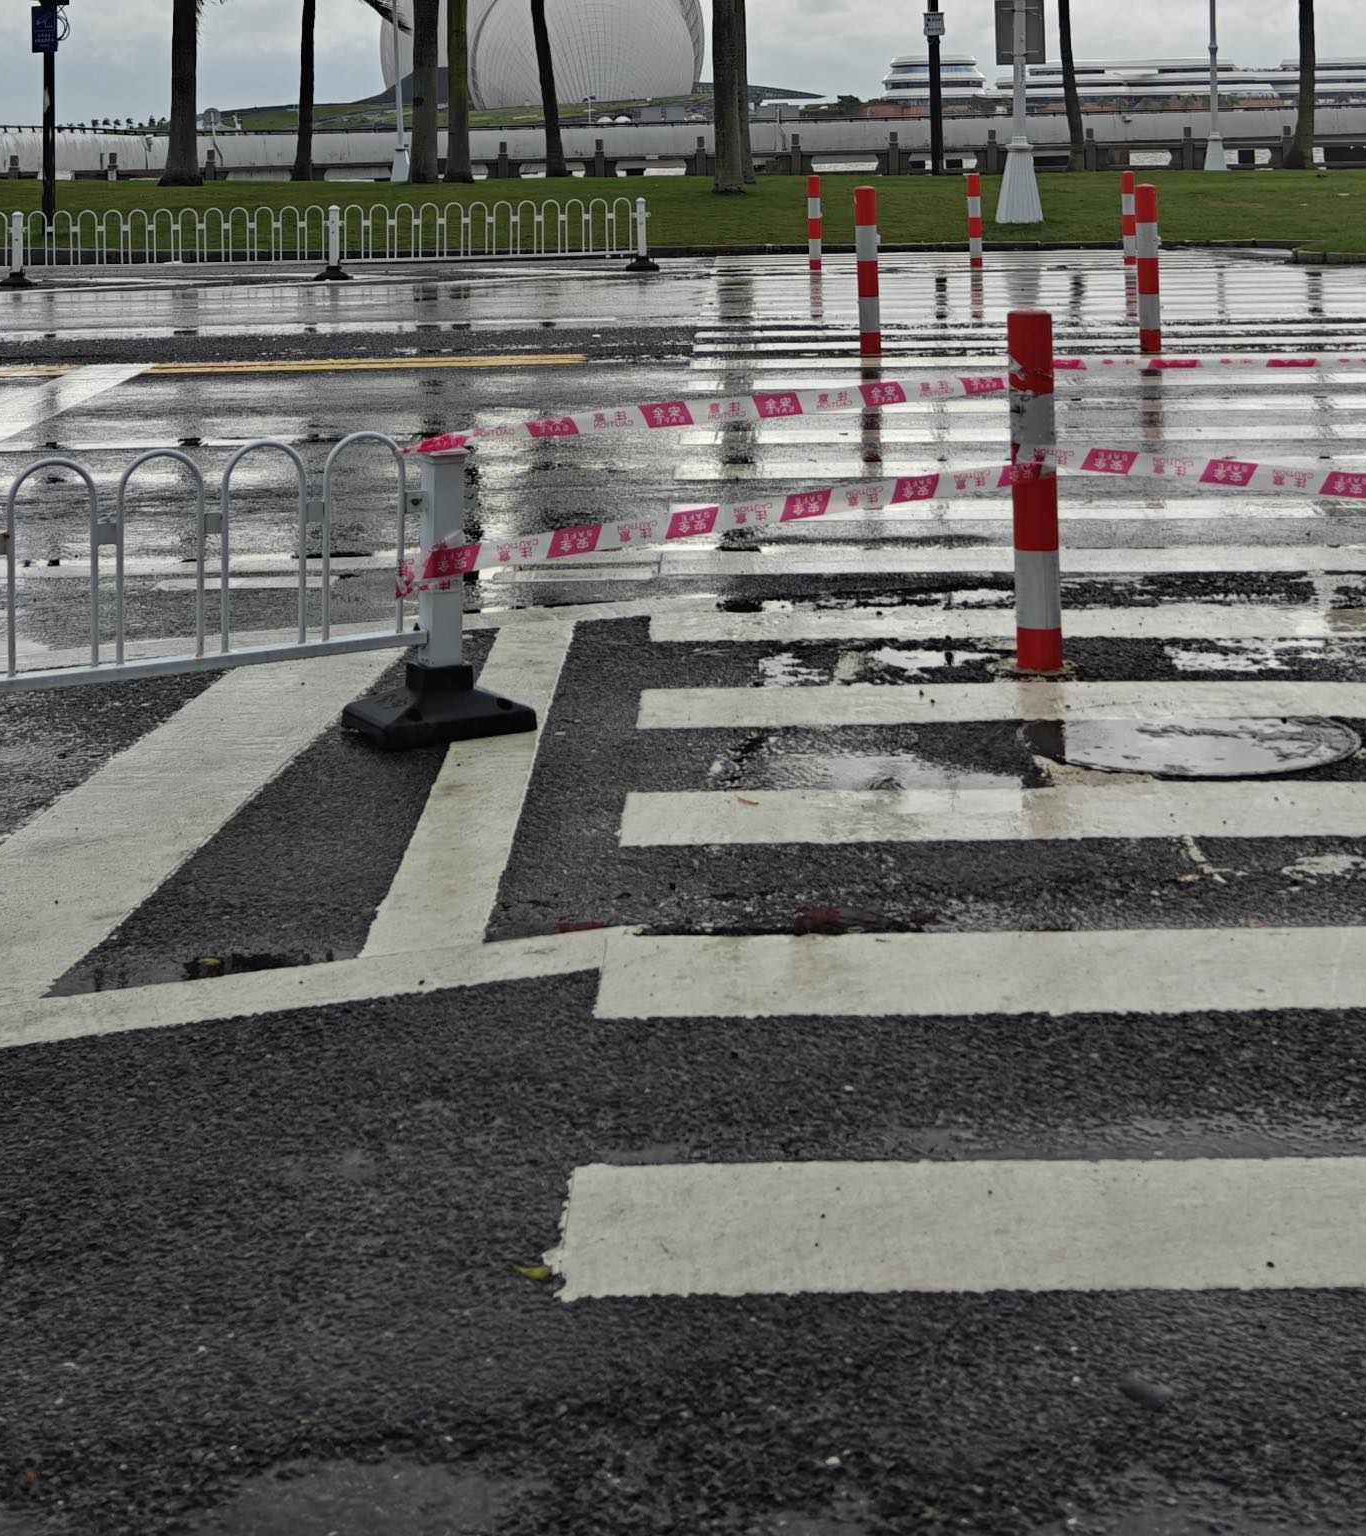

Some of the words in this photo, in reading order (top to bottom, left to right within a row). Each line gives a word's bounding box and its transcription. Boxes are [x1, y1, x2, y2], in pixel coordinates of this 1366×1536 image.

[845, 485, 884, 499] CAUTION
[902, 484, 929, 499] 安全
[793, 500, 820, 515] 安全
[794, 494, 824, 506] SAFE
[847, 494, 879, 507] 注意
[734, 501, 773, 515] CAUTION
[679, 510, 711, 524] SAFE
[735, 509, 768, 524] 注意
[617, 519, 658, 535] CAUTION
[678, 518, 707, 534] 安全
[561, 528, 592, 541] SAFE
[619, 527, 652, 543] 注意
[496, 538, 539, 552] CAUTION
[560, 535, 589, 552] 安全
[498, 546, 533, 562] 注意
